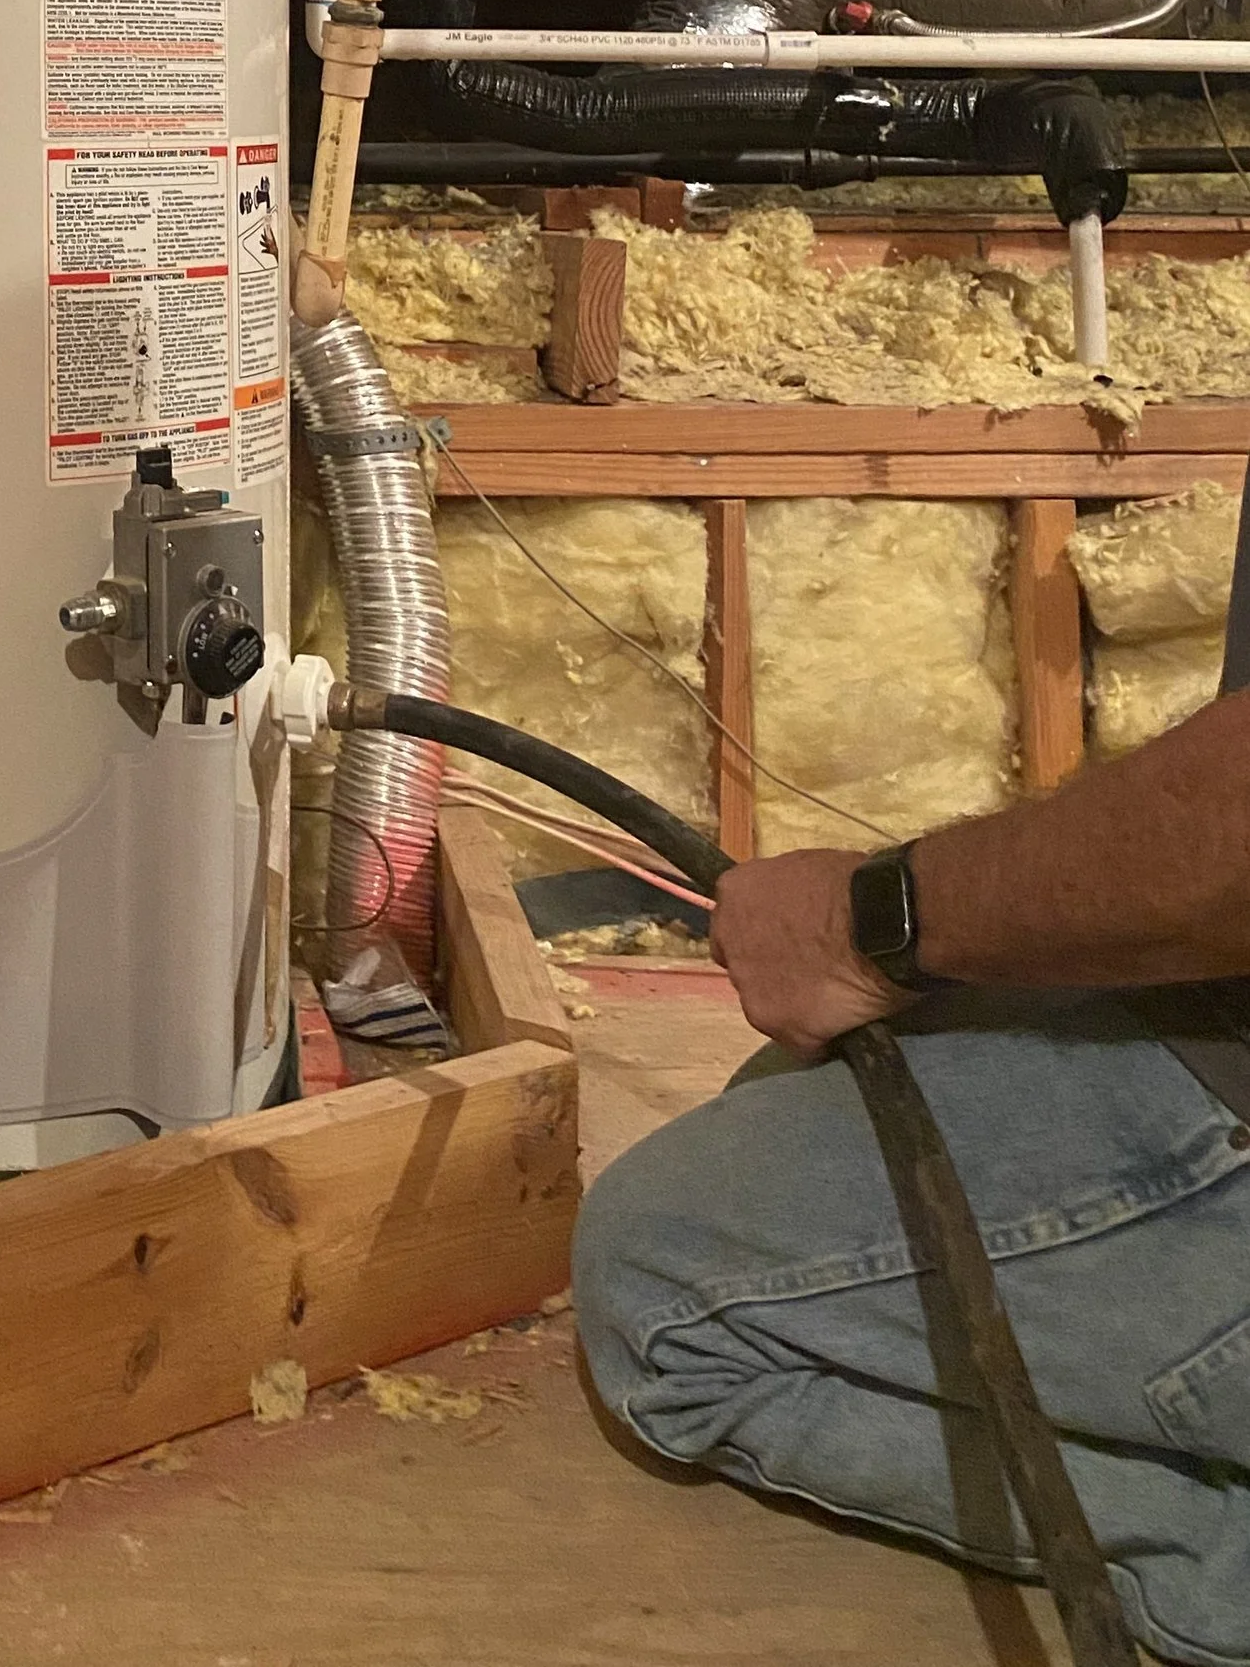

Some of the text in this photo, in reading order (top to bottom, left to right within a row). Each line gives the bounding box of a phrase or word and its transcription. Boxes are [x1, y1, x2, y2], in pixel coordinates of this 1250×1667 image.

[464, 33, 492, 43] Eagle
[592, 36, 610, 44] PVC
[614, 36, 633, 44] 1120
[669, 37, 677, 46] @
[706, 37, 731, 45] ASTM
[249, 148, 276, 161] DANGER
[113, 273, 185, 283] LIGHTING INSTRUCTIONS
[151, 431, 157, 439] TO
[169, 426, 194, 436] APPLIANCE
